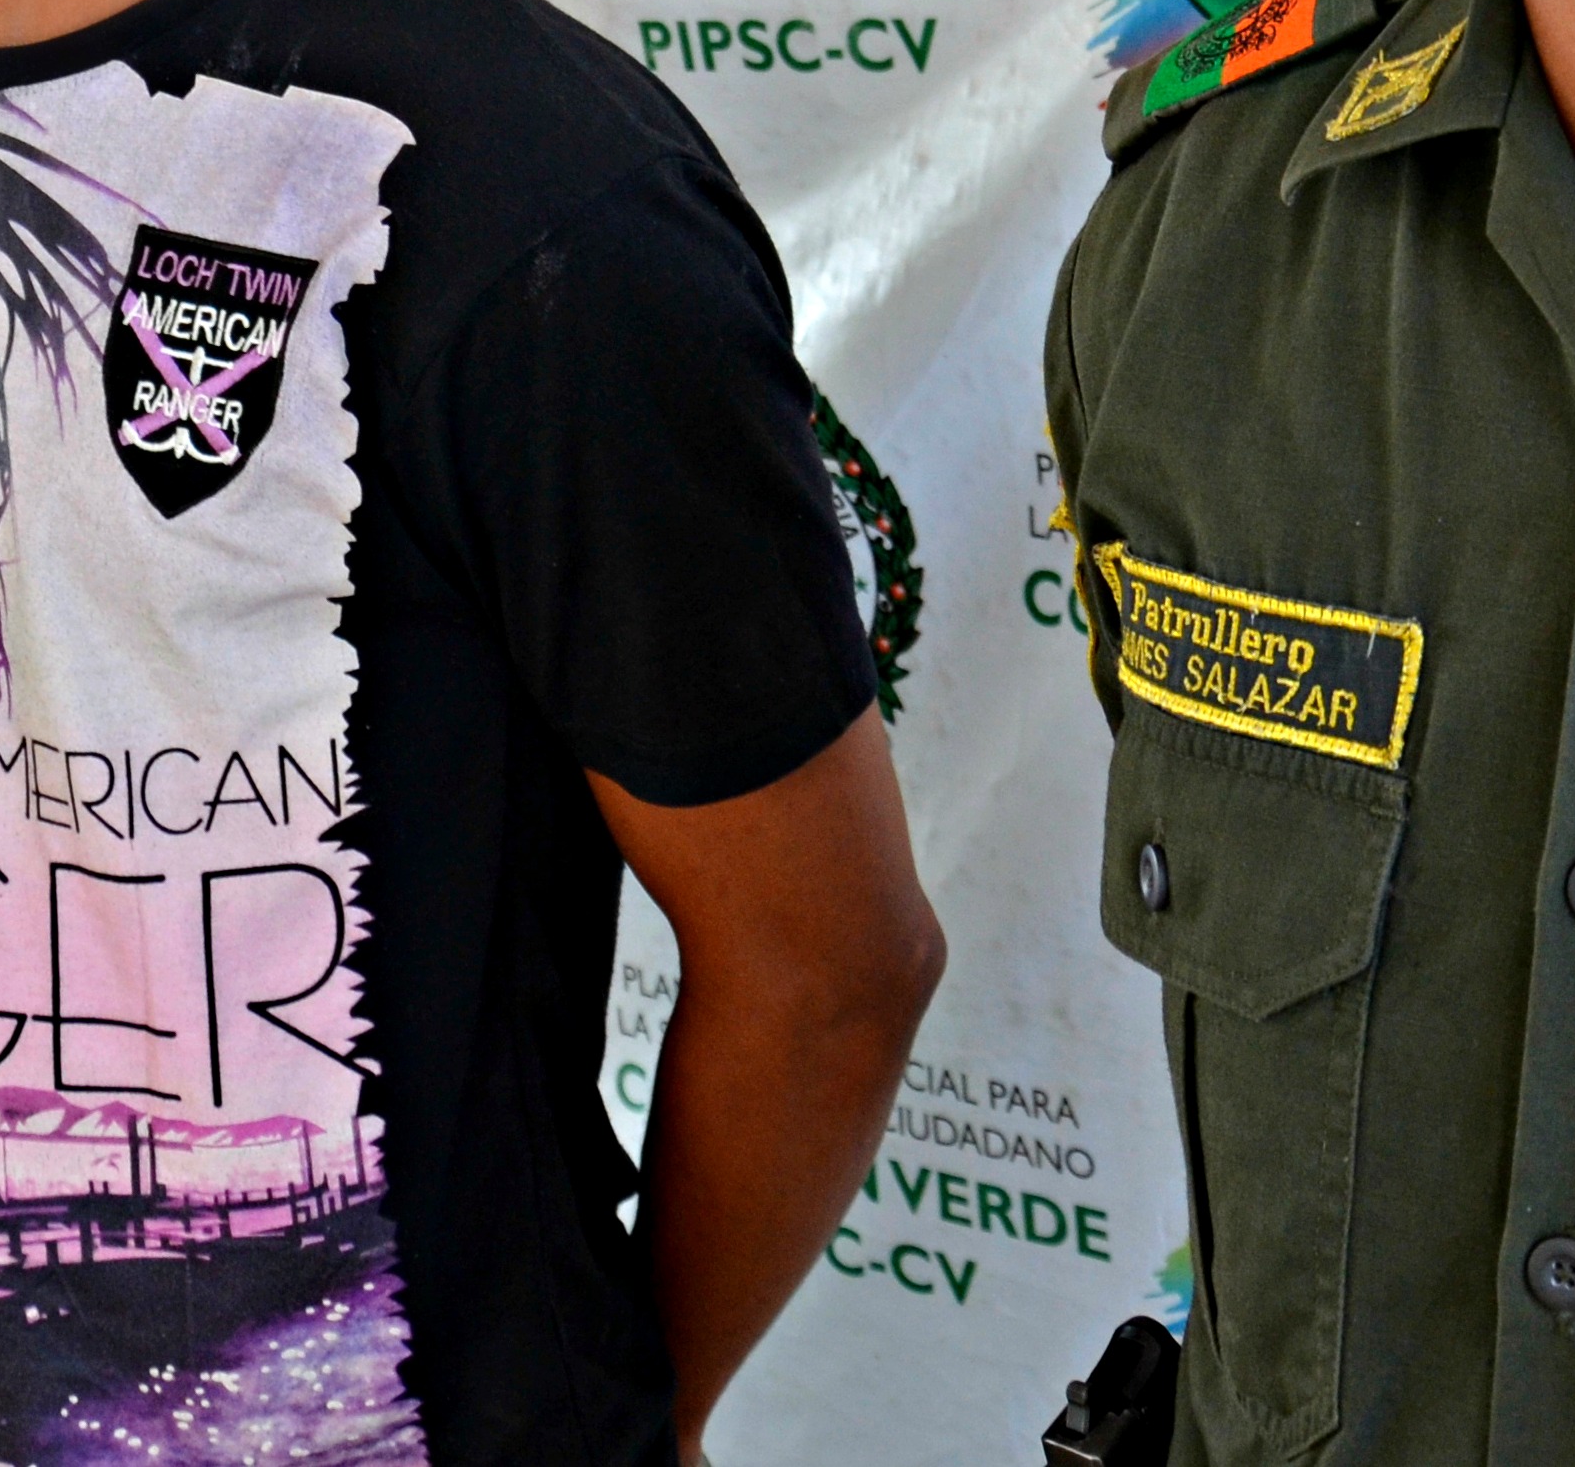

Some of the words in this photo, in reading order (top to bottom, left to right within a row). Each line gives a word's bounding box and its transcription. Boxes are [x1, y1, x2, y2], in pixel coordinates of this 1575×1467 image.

[638, 17, 938, 75] PIPSC-CV
[137, 246, 216, 291] LOCH
[227, 262, 302, 309] TWIN
[122, 291, 288, 359] AMERICAN
[133, 380, 244, 436] RANGER
[1130, 580, 1315, 676] Patrullero
[1183, 654, 1359, 733] SALAZAR
[617, 1007, 652, 1045] LA
[903, 1060, 978, 1106] CIAL
[988, 1080, 1080, 1129] PARA
[885, 1106, 1096, 1180] IUDADANO
[889, 1157, 1112, 1263] VERDE
[826, 1226, 978, 1306] C-CV
